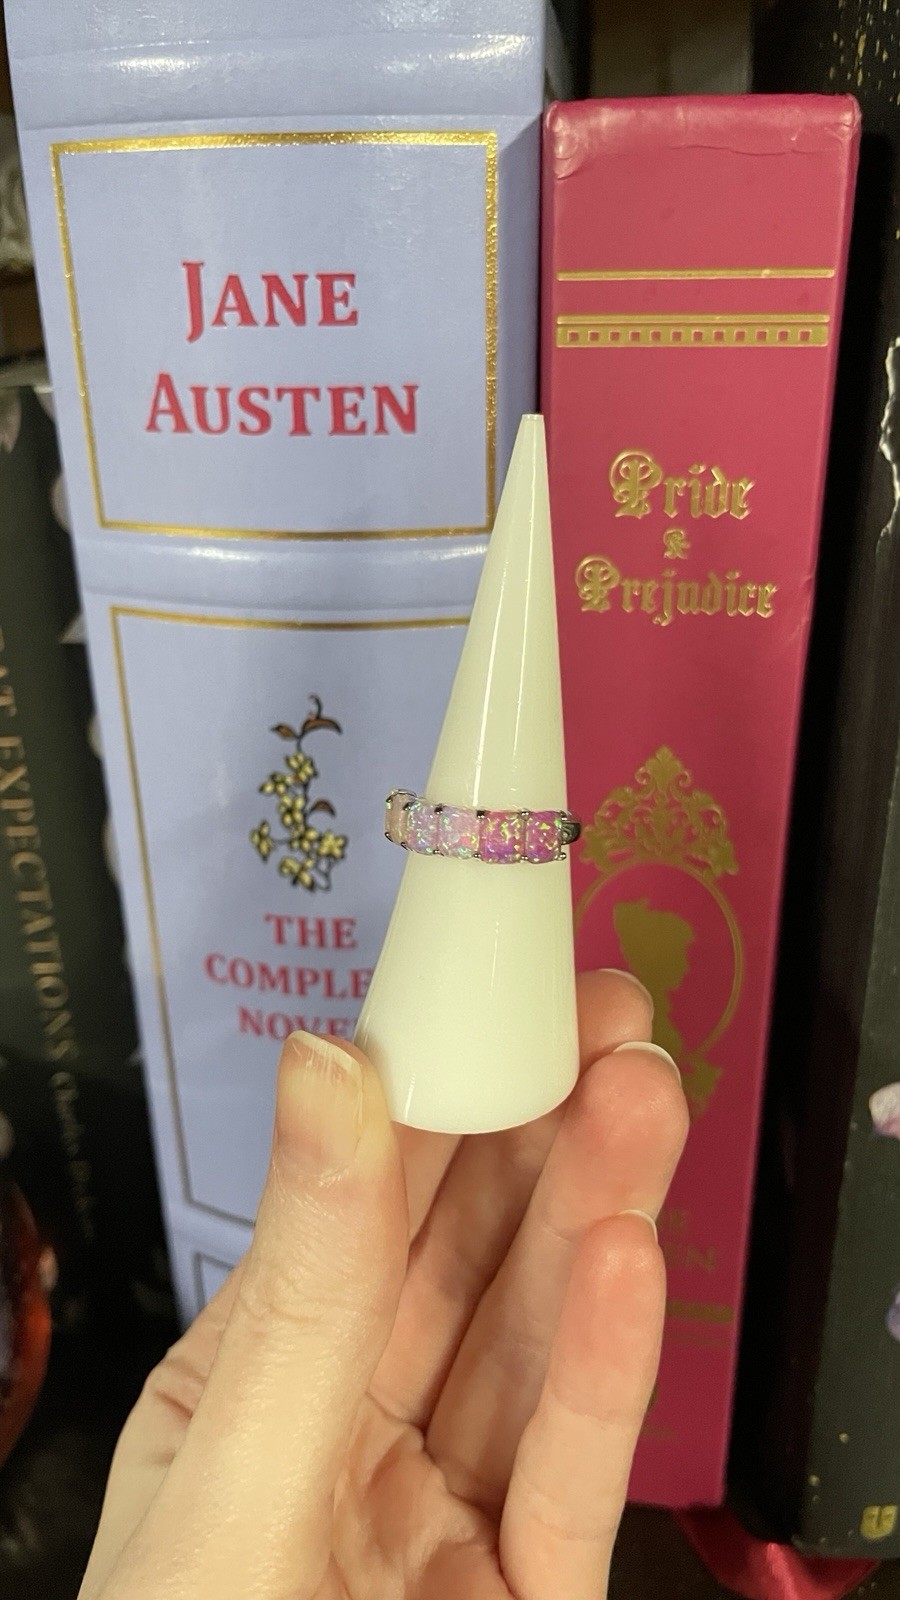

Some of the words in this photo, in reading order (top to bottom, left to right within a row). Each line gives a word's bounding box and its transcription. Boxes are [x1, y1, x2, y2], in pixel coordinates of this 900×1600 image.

[181, 260, 359, 343] JANE
[145, 371, 419, 436] AUSTEN
[609, 449, 755, 520] Pride
[575, 555, 778, 626] Prejudice
[0, 735, 78, 1061] EXPECTATIONS
[263, 912, 358, 950] THE
[236, 1003, 358, 1041] NOVE
